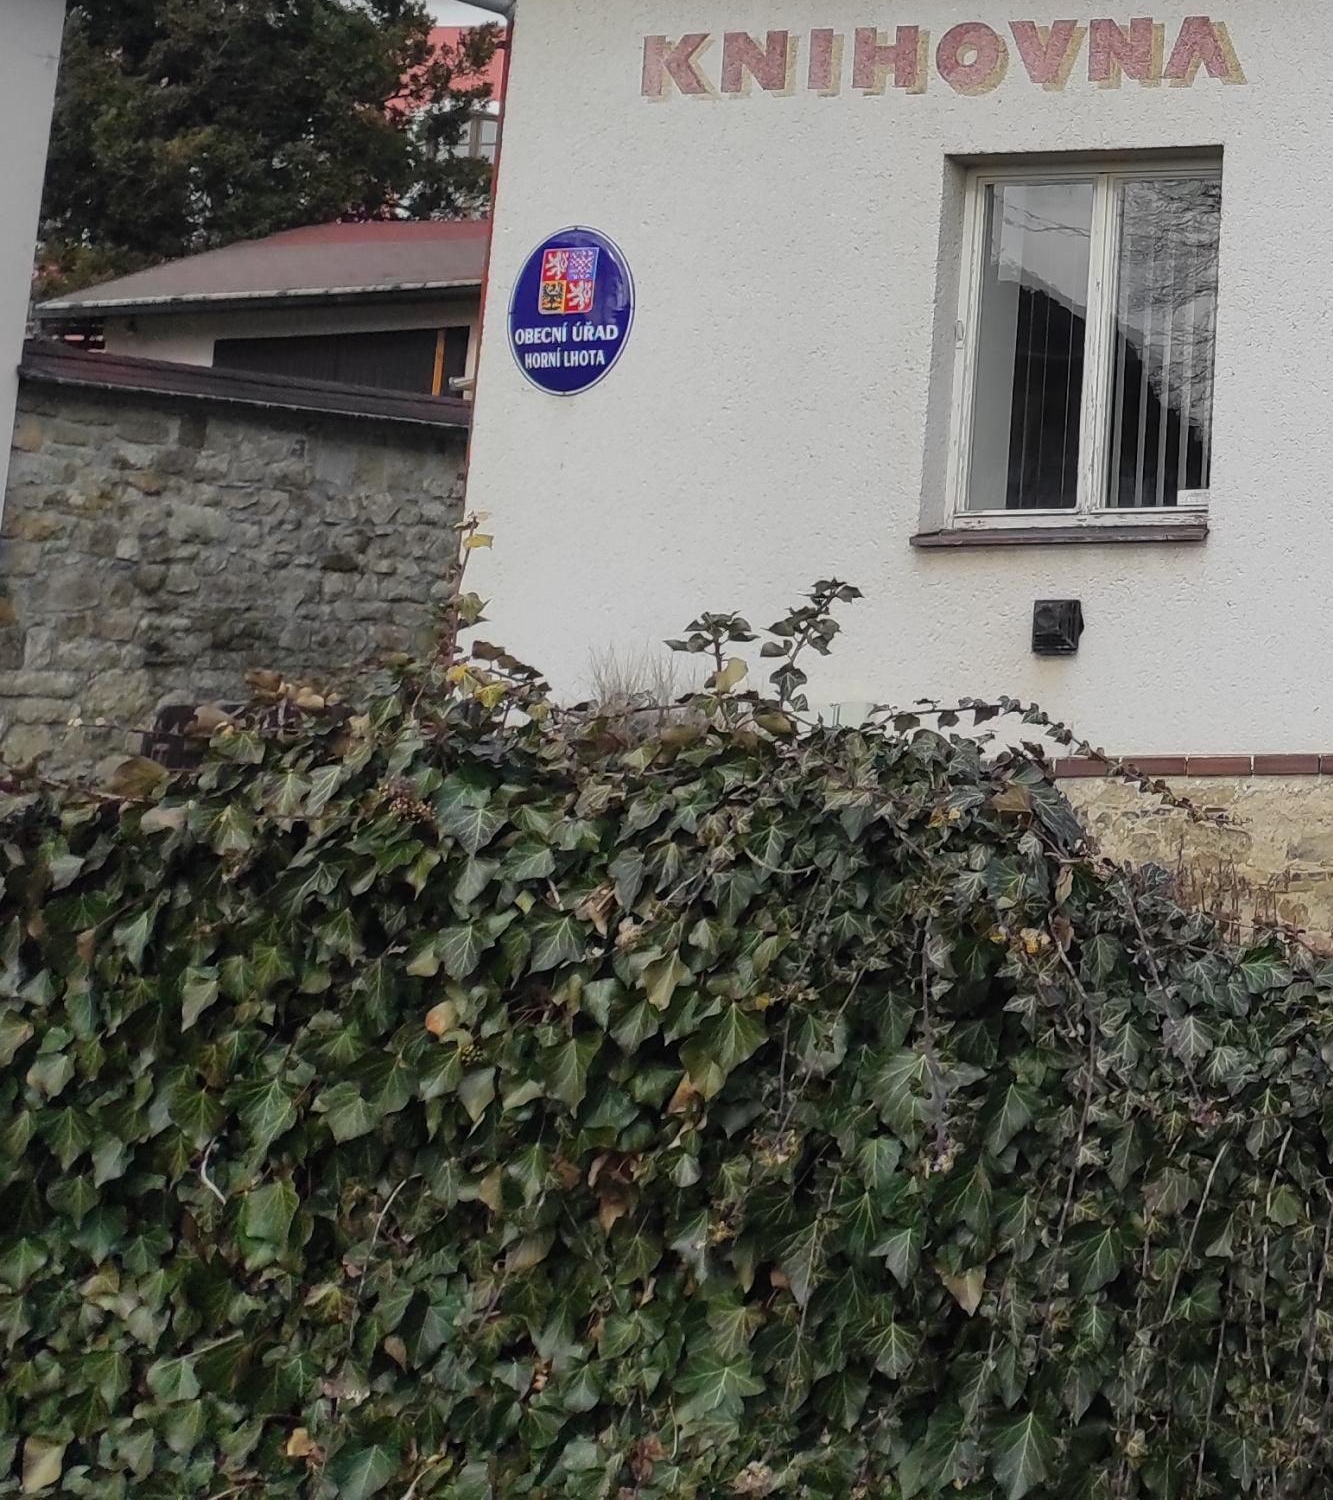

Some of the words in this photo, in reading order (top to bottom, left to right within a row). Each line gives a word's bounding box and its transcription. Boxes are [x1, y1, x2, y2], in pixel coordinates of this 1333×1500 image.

[641, 16, 1248, 101] KNIHOVNA
[515, 321, 567, 345] OBECNÍ
[572, 321, 619, 341] ÚŘAD
[525, 348, 561, 369] HORNÍ
[564, 350, 605, 367] LHOTA
